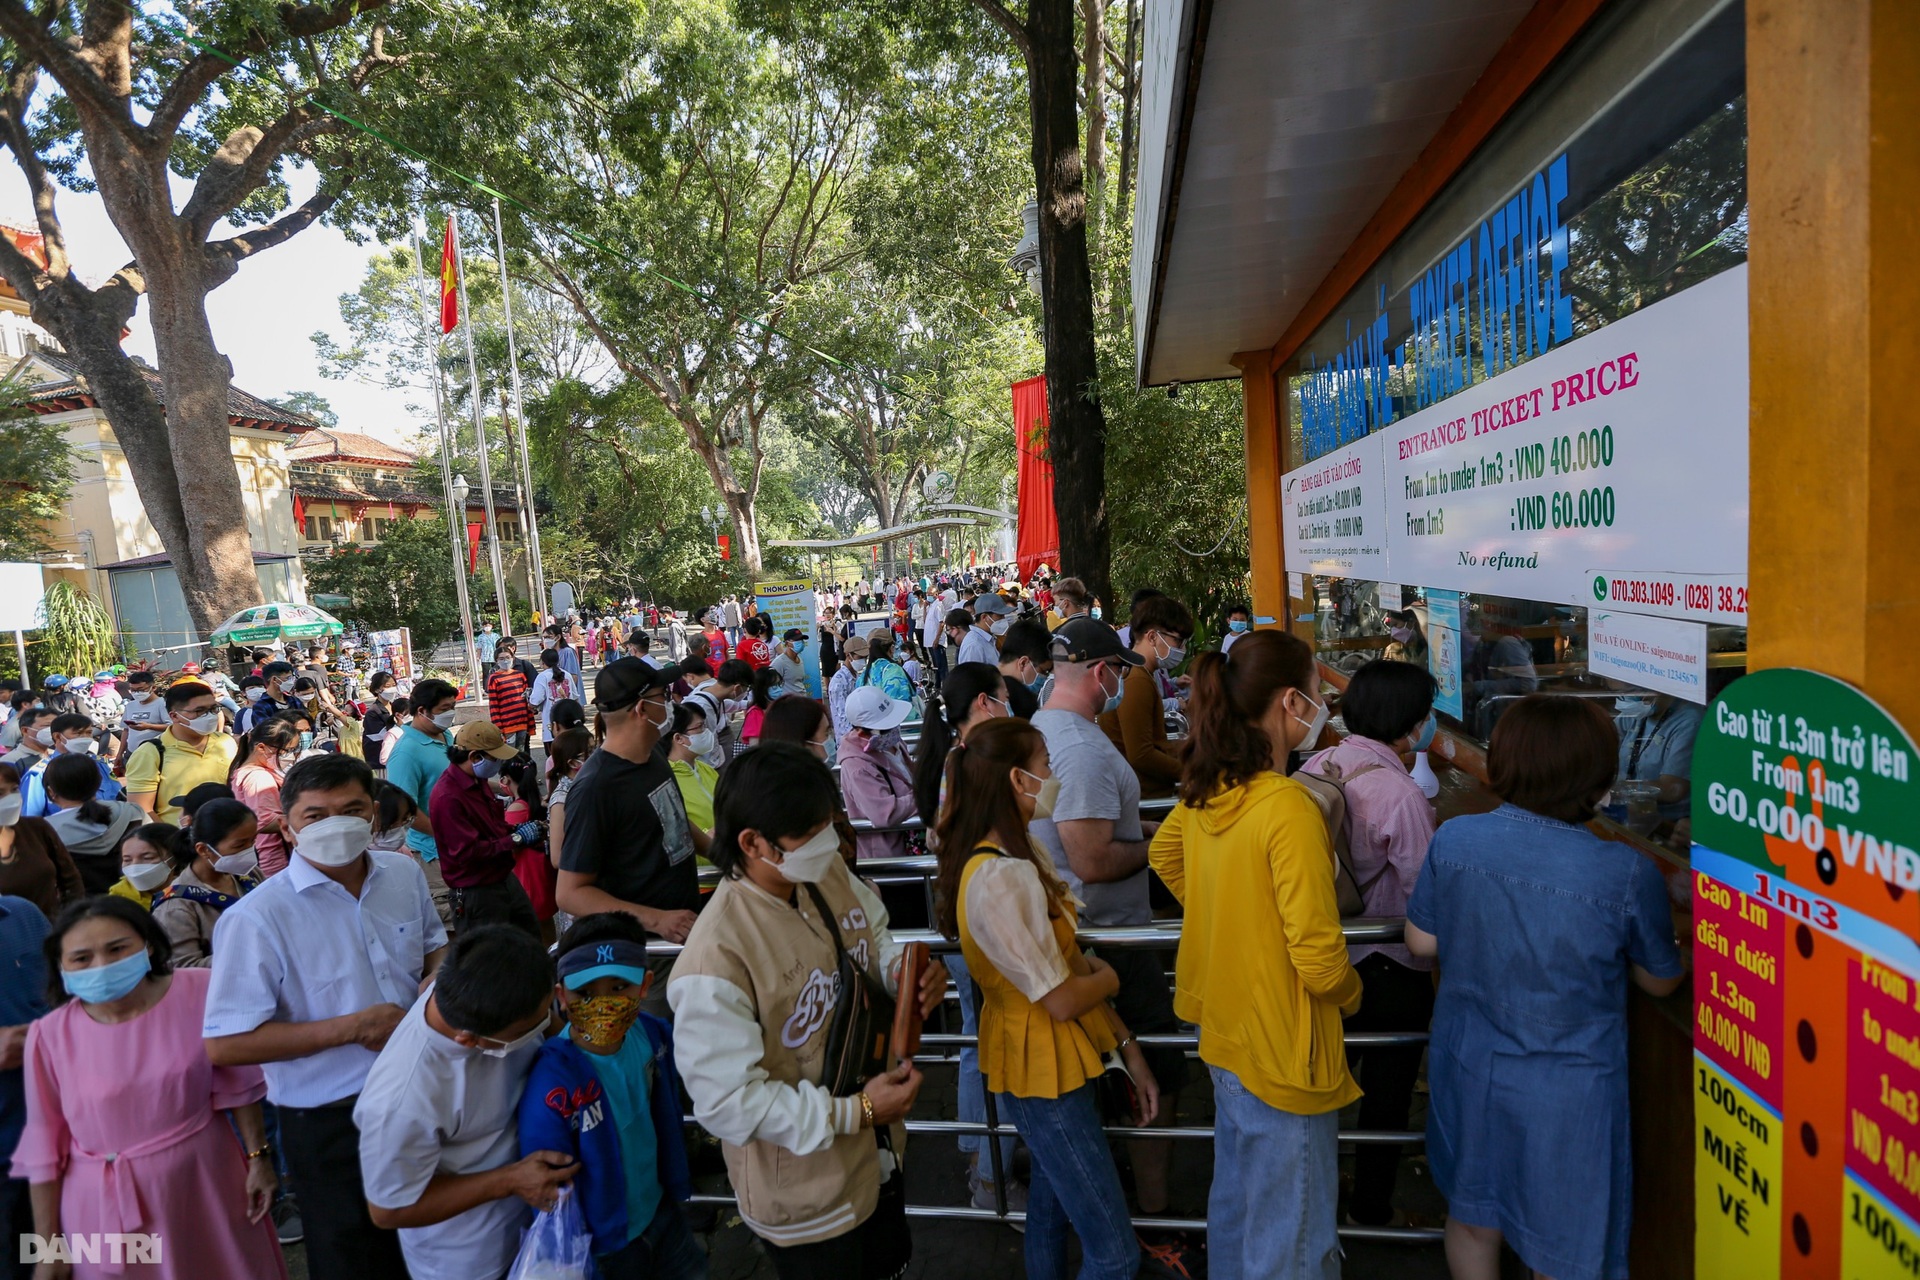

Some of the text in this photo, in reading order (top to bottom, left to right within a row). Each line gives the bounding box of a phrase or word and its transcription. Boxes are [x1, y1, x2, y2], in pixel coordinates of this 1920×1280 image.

[1367, 284, 1392, 429] VÉ
[1410, 238, 1473, 407] TICKET
[1478, 153, 1573, 378] OFFICE
[1399, 351, 1640, 461] ENTRANCE TICKET PRICE
[1323, 465, 1331, 485] VÉ
[1405, 475, 1424, 500] From
[1425, 470, 1438, 497] 1m
[1439, 471, 1448, 494] to
[1450, 461, 1477, 492] under
[1480, 451, 1504, 487] 1m3
[1550, 424, 1614, 475] 40.000
[1406, 511, 1426, 536] From
[1427, 507, 1445, 536] 1m3
[1552, 485, 1615, 530] 60.000
[1457, 551, 1539, 571] No refund
[1612, 579, 1674, 606] 070.303.1049
[1684, 583, 1713, 613] (028)
[1593, 633, 1697, 665] MUA VÉ ONLINE: saigonzoo.net
[1593, 650, 1610, 663] WIFI:
[1649, 664, 1665, 677] Pass:
[1667, 669, 1698, 686] 12345678
[1716, 700, 1908, 783] Cao từ 1.3m trở lên
[1751, 749, 1860, 814] From 1m3
[1707, 781, 1920, 892] 60.000 VNĐ
[1697, 871, 1768, 930] Cao 1m
[1754, 873, 1839, 931] 1m3
[1697, 918, 1776, 986] đến dưới
[1861, 952, 1908, 1005] From
[1710, 971, 1756, 1023] 1.3m
[1697, 1001, 1771, 1080] 40.000 VNĐ
[1863, 1007, 1920, 1072] to und
[1699, 1068, 1769, 1146] 100cm
[1879, 1073, 1918, 1125] 1m3
[1703, 1124, 1769, 1207] MIỄN
[1884, 1134, 1920, 1200] 40.0
[1717, 1182, 1750, 1237] VÉ
